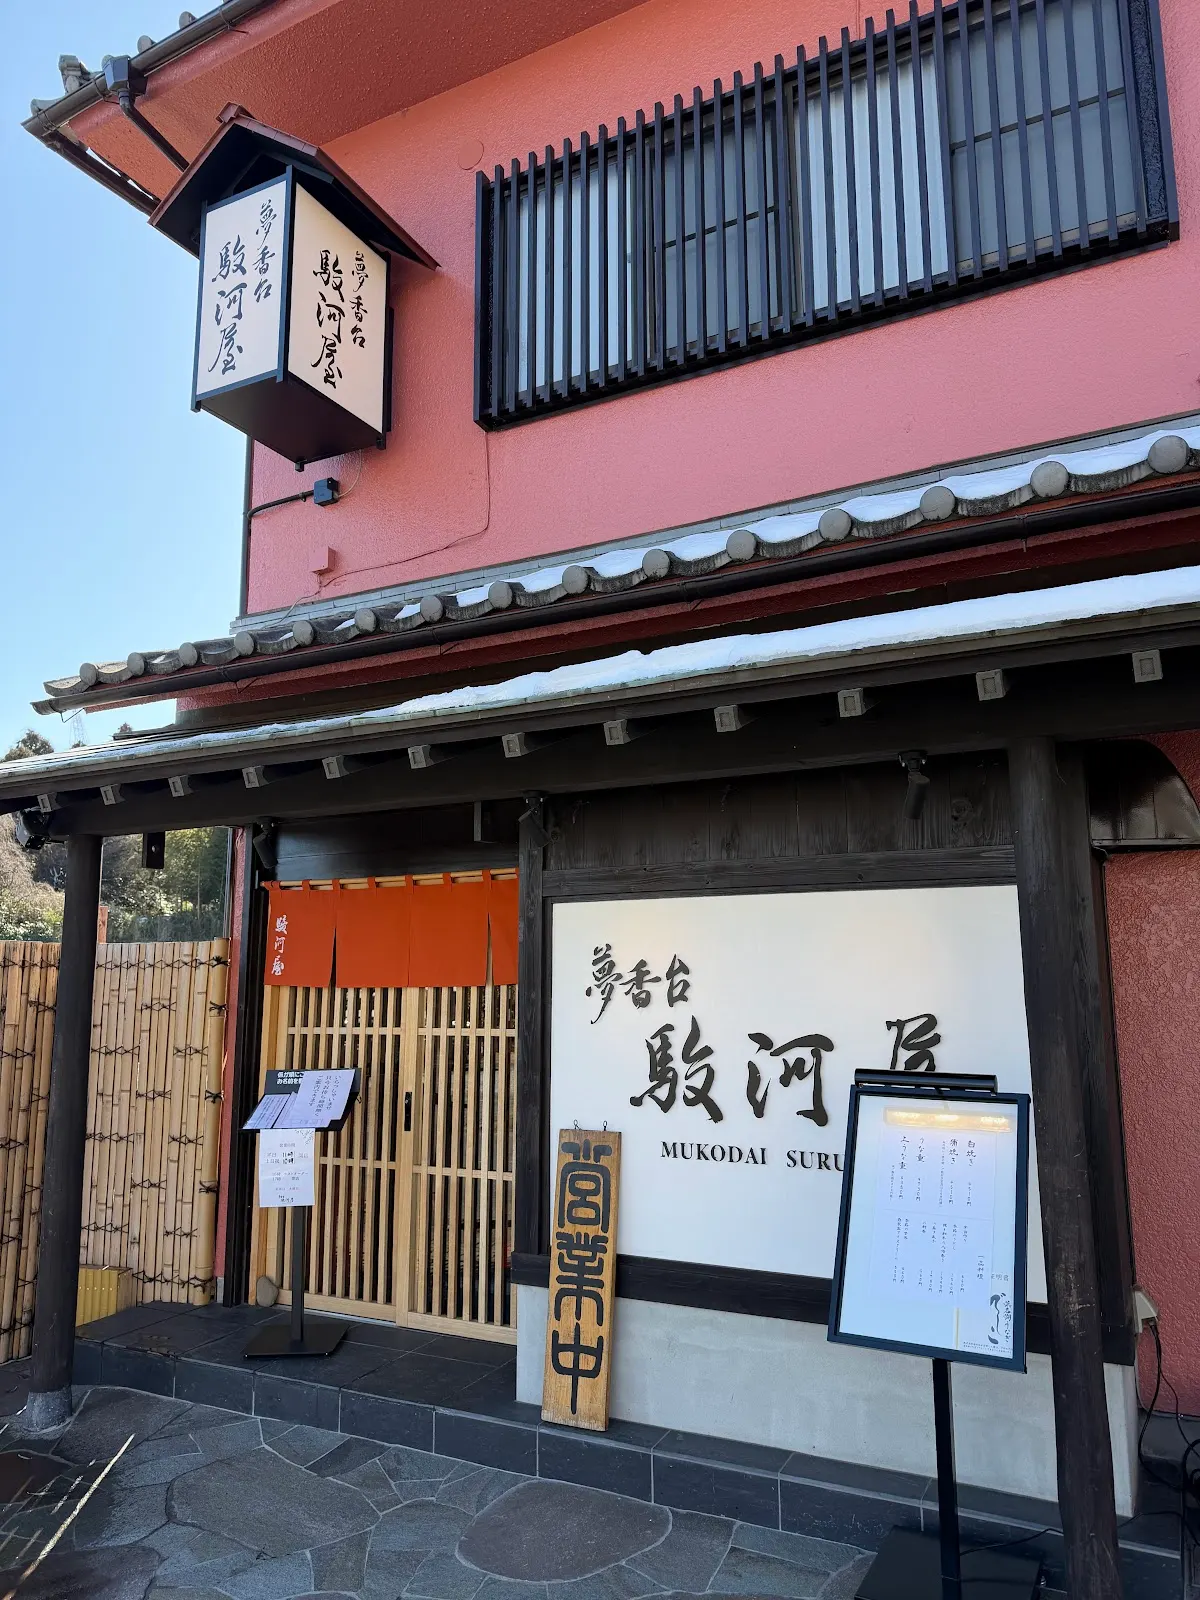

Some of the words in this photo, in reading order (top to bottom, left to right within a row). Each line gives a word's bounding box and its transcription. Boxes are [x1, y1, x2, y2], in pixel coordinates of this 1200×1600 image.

[253, 199, 277, 302] 夢香台
[348, 250, 369, 349] 夢香台
[207, 234, 248, 376] 駿河屋
[310, 249, 346, 390] 駿河屋
[271, 914, 289, 976] 駿河屋
[585, 943, 692, 1024] 夢香台
[660, 1140, 767, 1165] MUKODAI
